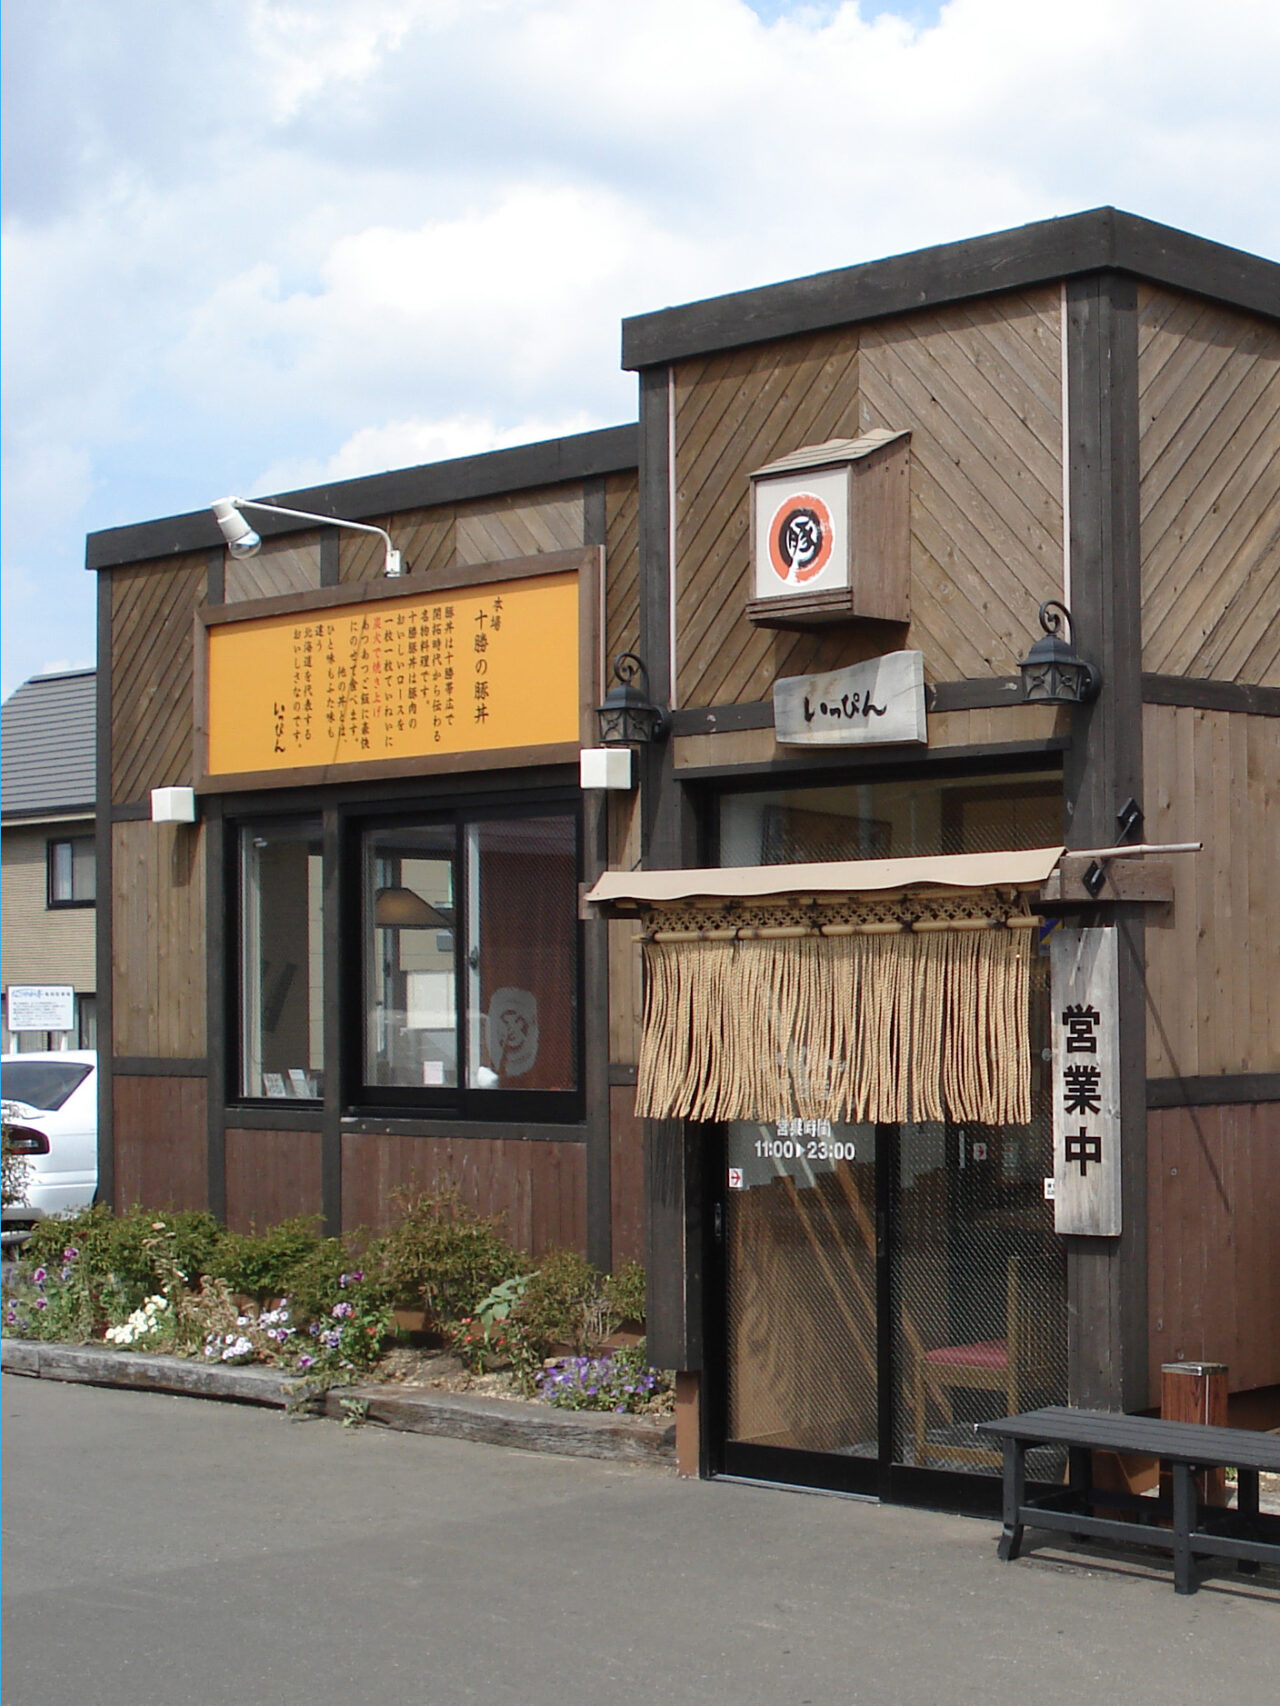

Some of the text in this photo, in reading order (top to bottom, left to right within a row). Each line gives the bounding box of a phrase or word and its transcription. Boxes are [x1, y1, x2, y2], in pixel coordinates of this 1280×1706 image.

[408, 611, 418, 729] 十勝豚丼は豚肉の
[474, 610, 490, 725] 十勝の豚丼
[490, 597, 504, 631] 本場
[303, 627, 313, 741] 北海道を代表する
[384, 617, 394, 748] 一枚一枚ていねいに
[396, 614, 406, 732] おいしいロースを
[431, 607, 443, 743] 開拓時代から伝わる
[803, 689, 888, 723] いっぴん
[1062, 1004, 1101, 1177] 営業中
[754, 1140, 856, 1160] 11:00 23:00
